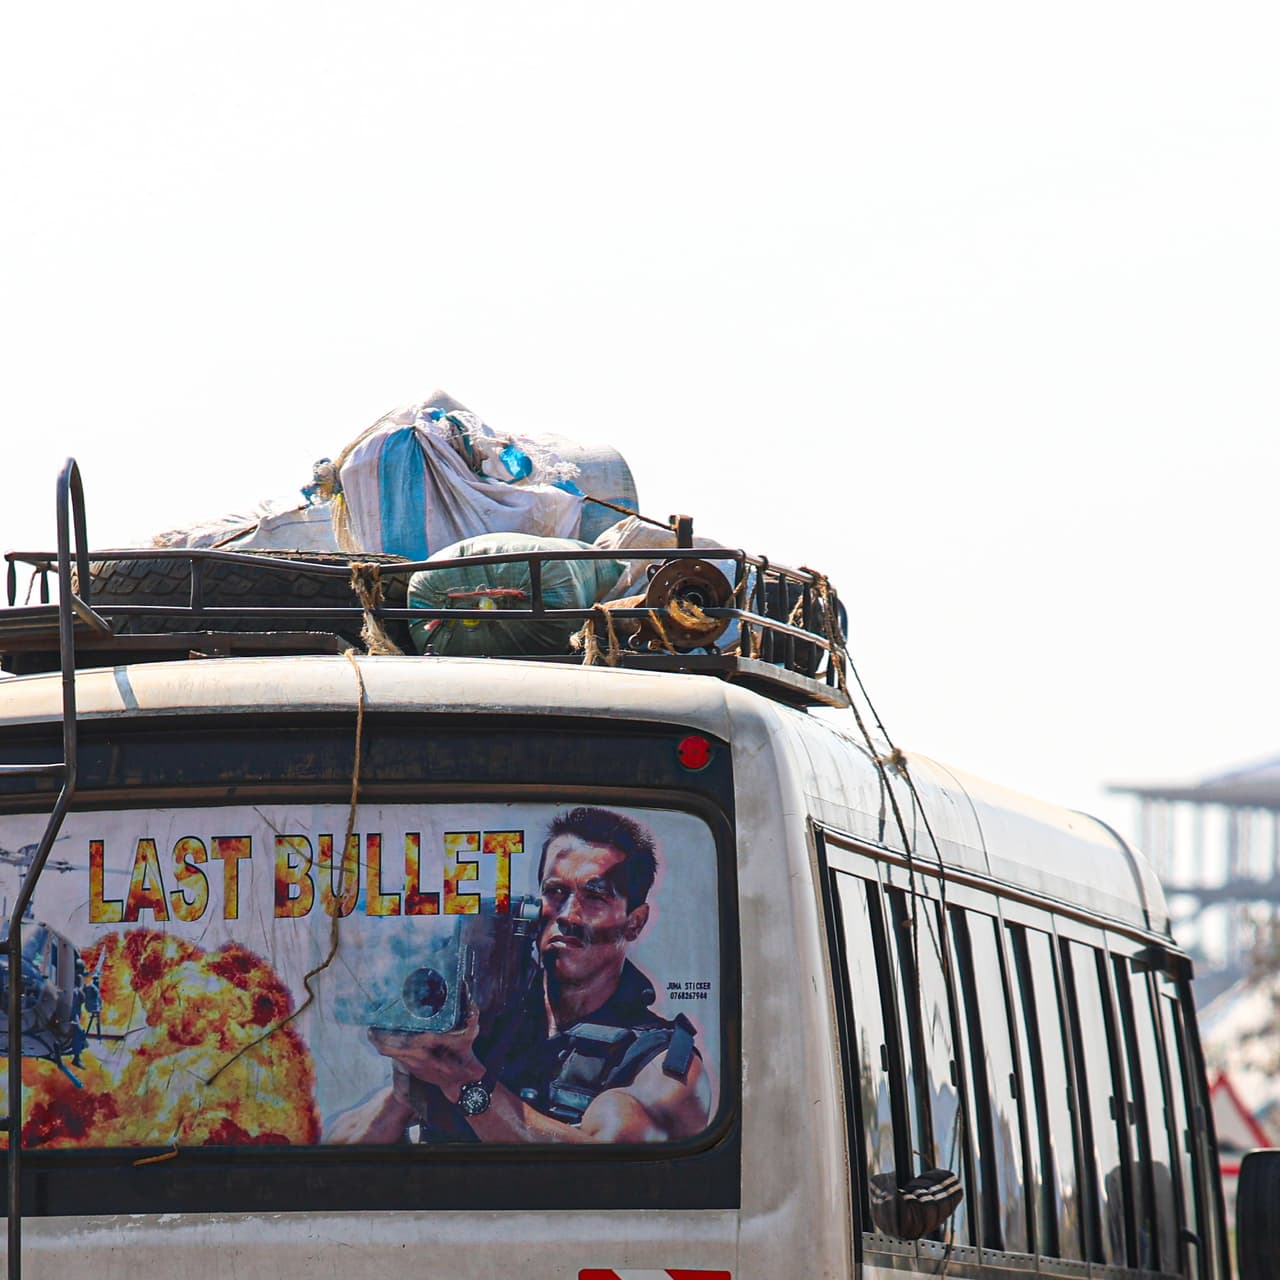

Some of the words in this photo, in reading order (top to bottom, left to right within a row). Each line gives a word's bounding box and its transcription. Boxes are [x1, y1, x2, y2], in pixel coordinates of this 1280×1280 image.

[88, 835, 252, 924] LAST
[274, 830, 525, 919] BULLET
[684, 982, 711, 991] STICKER
